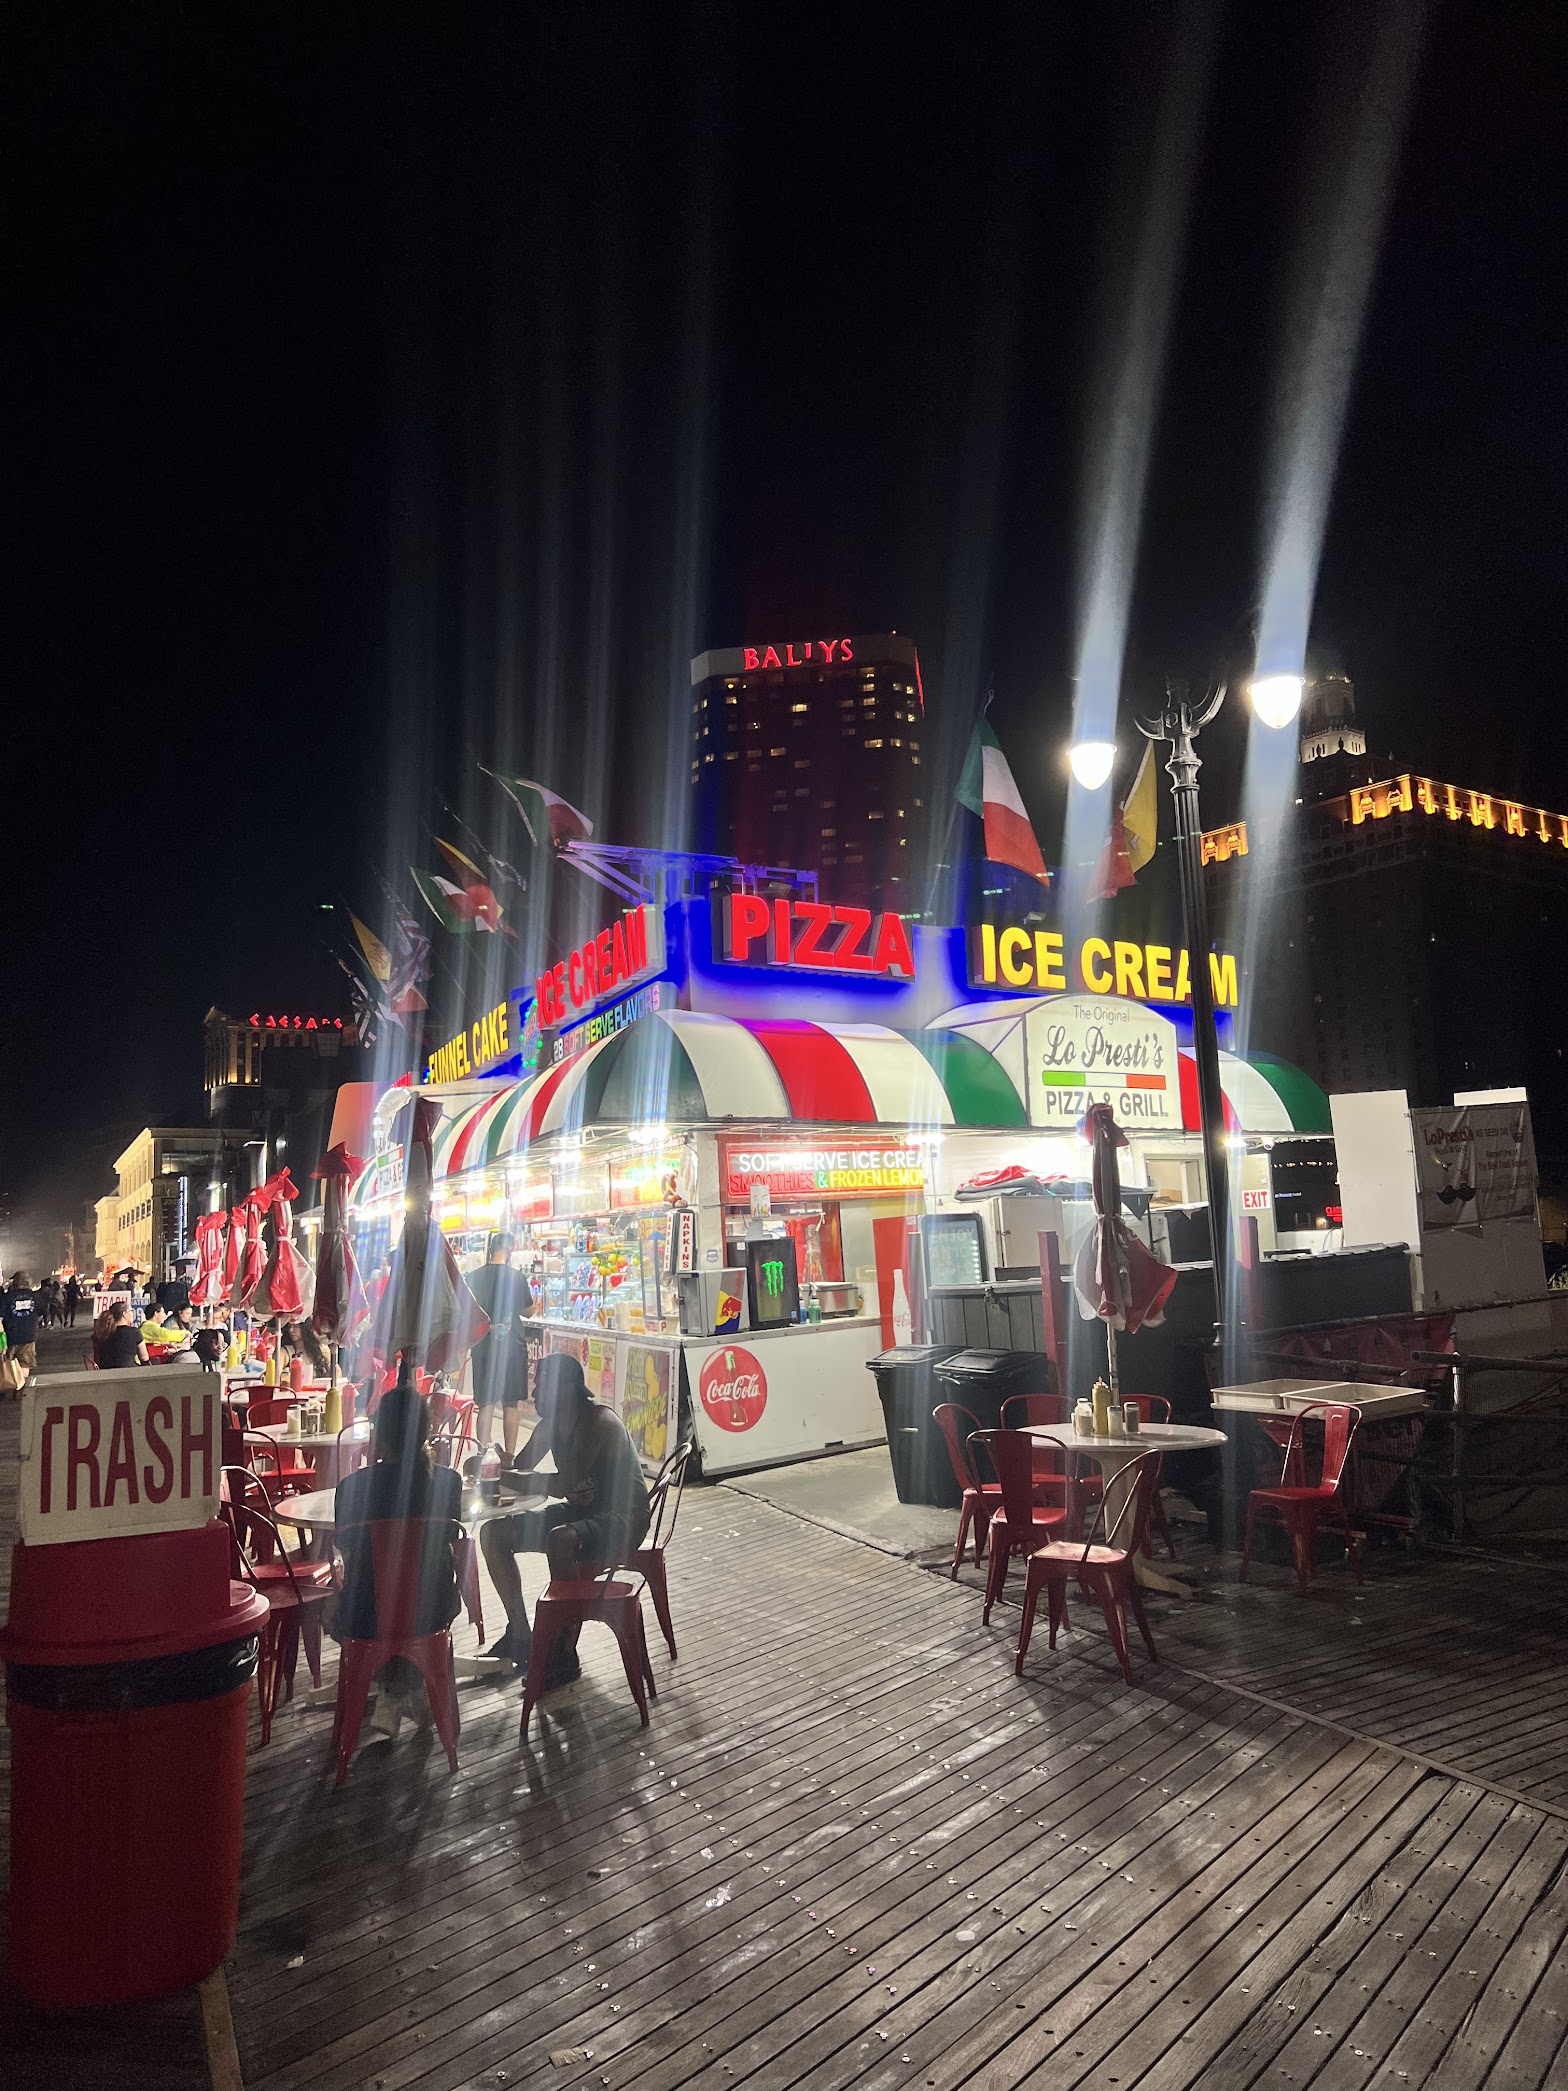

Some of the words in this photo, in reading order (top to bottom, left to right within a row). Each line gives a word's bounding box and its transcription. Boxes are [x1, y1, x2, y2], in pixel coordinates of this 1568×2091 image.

[731, 893, 915, 975] PIZZA
[536, 961, 566, 1030] ICE
[569, 903, 647, 1009] CREAM
[981, 924, 1066, 989] ICE
[1080, 938, 1239, 1007] CREAM
[554, 1038, 563, 1062] 28
[564, 1028, 584, 1056] SOFT
[585, 1012, 614, 1046] SERVE
[614, 985, 660, 1031] FLAVORS
[1073, 1004, 1091, 1020] The
[1094, 1006, 1130, 1025] Original
[429, 1031, 470, 1085] FUNNEL
[473, 1002, 508, 1067] CAKE
[1043, 1025, 1077, 1066] Lo
[1081, 1025, 1164, 1069] Presti's
[1120, 1092, 1169, 1117] GRILL
[1485, 1128, 1499, 1137] SEEN
[739, 1152, 787, 1173] SOFT
[792, 1151, 848, 1172] SERVE
[852, 1151, 880, 1170] ICE
[730, 1172, 815, 1193] SMOOTHIES
[817, 1171, 829, 1188] &
[829, 1170, 882, 1188] FROZEN
[1244, 1191, 1267, 1208] EXIT
[97, 1295, 128, 1314] TRA
[706, 1374, 761, 1404] Coca-Cola
[40, 1395, 213, 1514] TRASH
